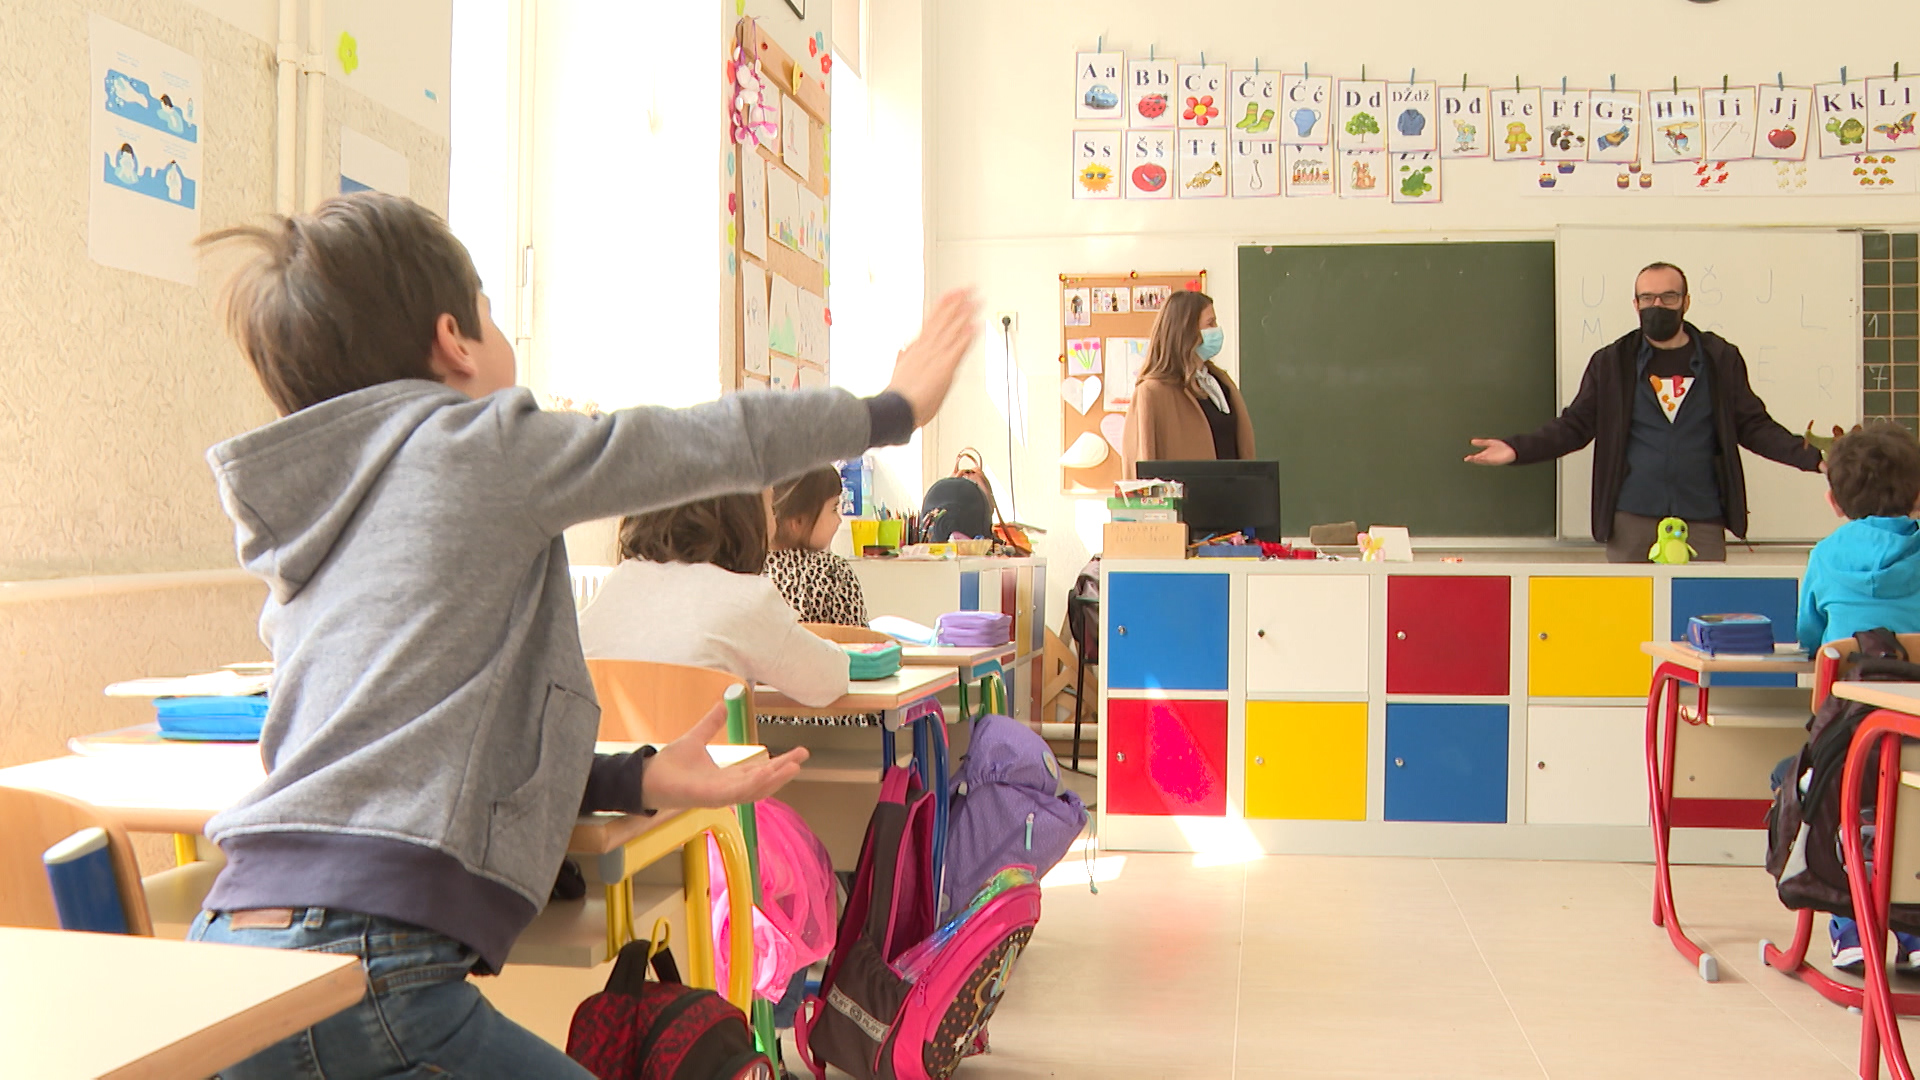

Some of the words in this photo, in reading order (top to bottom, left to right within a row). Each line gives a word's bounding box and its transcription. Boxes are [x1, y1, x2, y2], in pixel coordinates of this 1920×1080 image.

[1083, 62, 1097, 79] A
[1106, 65, 1115, 78] a
[1136, 69, 1150, 86] B
[1157, 69, 1169, 85] b
[1185, 74, 1201, 91] C
[1209, 79, 1218, 91] c
[1239, 76, 1255, 98] Č
[1263, 80, 1272, 98] č
[1290, 79, 1308, 102] Ć
[1314, 86, 1323, 104] ć
[1346, 89, 1361, 107] D
[1369, 91, 1381, 108] d
[1823, 93, 1842, 113] K
[1851, 90, 1864, 110] k
[1880, 88, 1896, 106] L
[1905, 87, 1910, 105] l
[1501, 99, 1515, 117] E
[1523, 103, 1533, 116] e
[1553, 99, 1566, 117] F
[1574, 100, 1583, 118] f
[1596, 101, 1614, 119] G
[1622, 106, 1633, 122] g
[1657, 101, 1674, 118] H
[1682, 100, 1695, 116] h
[1719, 99, 1726, 117] I
[1735, 98, 1741, 116] i
[1770, 97, 1783, 115] J
[1789, 98, 1797, 121] j
[1084, 141, 1095, 158] S
[1103, 146, 1110, 157] s
[1136, 136, 1148, 158] Š
[1156, 138, 1165, 157] š
[1188, 139, 1203, 155] T
[1211, 140, 1217, 156] t
[1239, 141, 1253, 156] U
[1262, 142, 1273, 155] u
[1868, 313, 1879, 338] 1
[1868, 364, 1889, 391] 7
